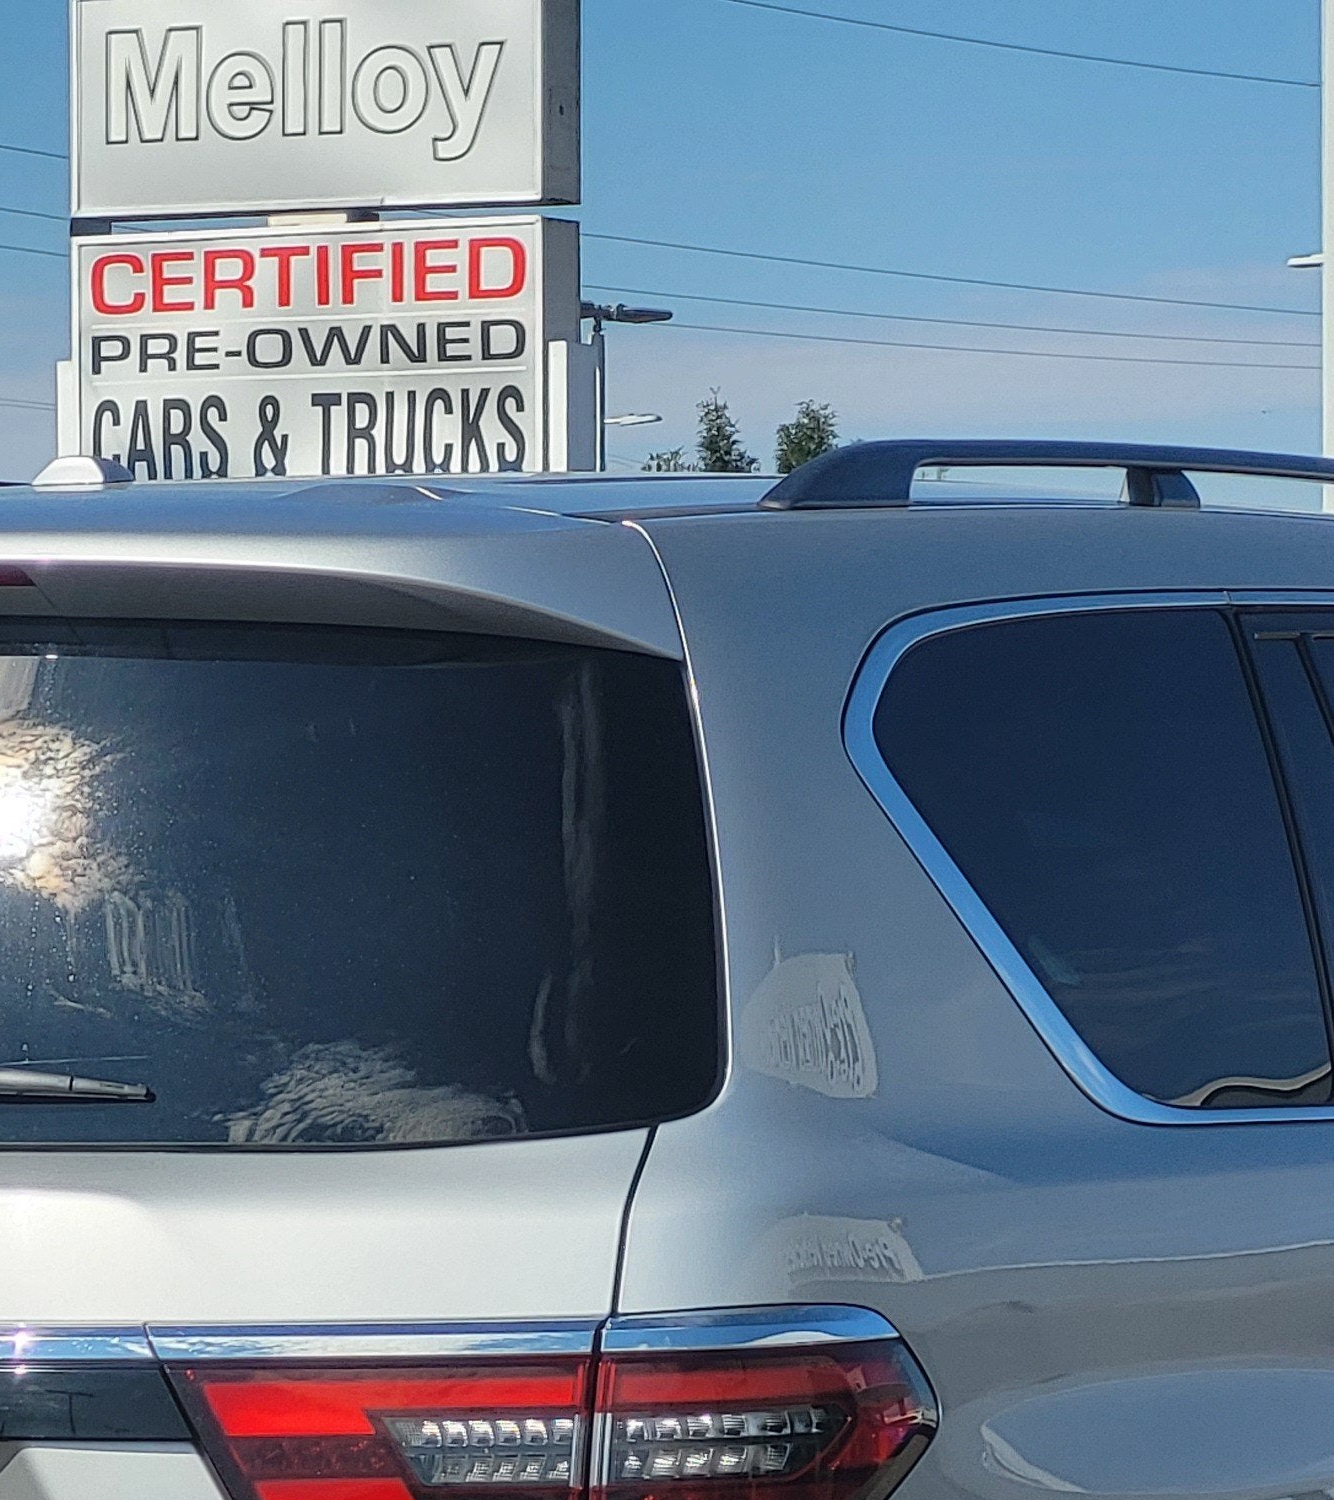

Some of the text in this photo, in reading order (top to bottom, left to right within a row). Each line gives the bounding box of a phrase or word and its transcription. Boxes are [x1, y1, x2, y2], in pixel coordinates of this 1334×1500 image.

[105, 18, 506, 162] Melloy
[90, 237, 527, 316] CERTIFIED
[91, 319, 527, 376] PRE-OWNED
[92, 384, 526, 480] CARS & TRUCKS
